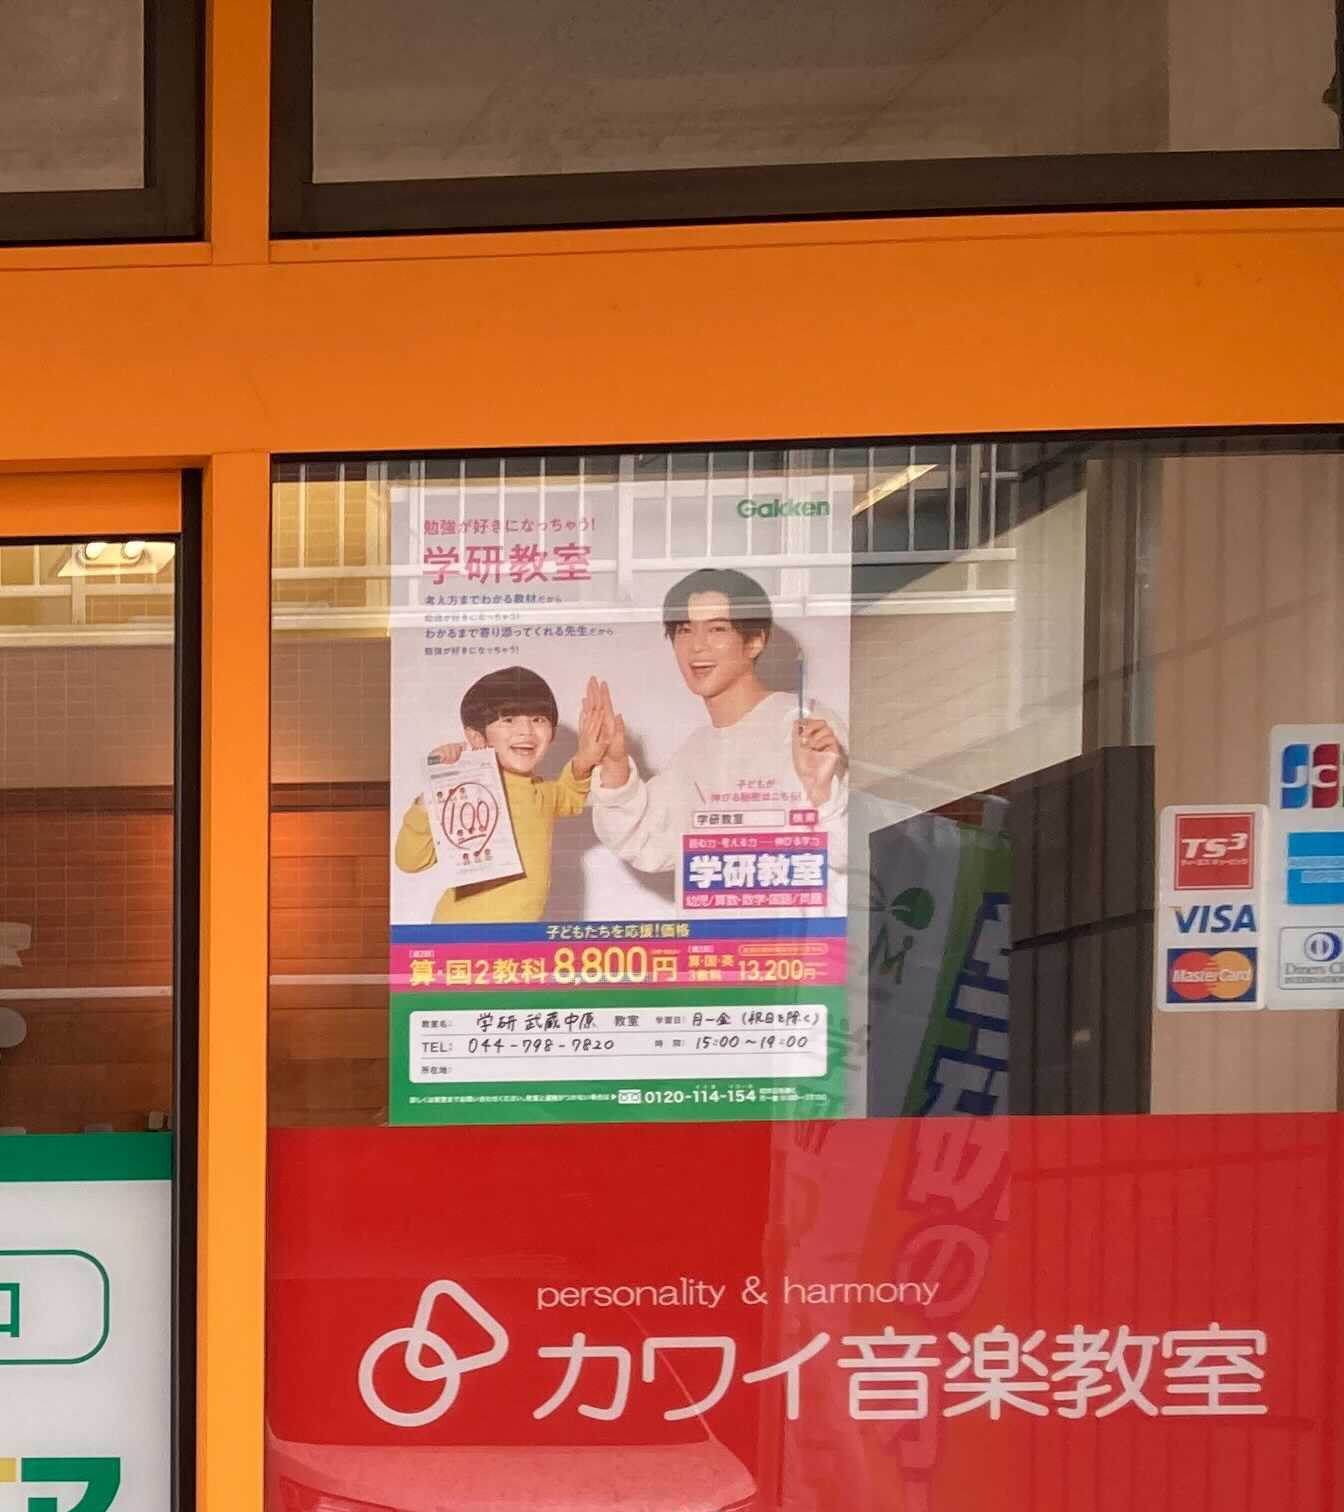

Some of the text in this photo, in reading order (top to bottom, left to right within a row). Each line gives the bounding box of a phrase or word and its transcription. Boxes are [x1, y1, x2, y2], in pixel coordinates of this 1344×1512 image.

[736, 498, 830, 519] Gakken
[423, 542, 592, 585] 学研教室
[689, 853, 824, 888] 学研教室
[1169, 904, 1257, 933] VISA
[546, 923, 689, 940] 子どもたちを応援!価格
[1172, 968, 1251, 983] MasterCard
[477, 1013, 517, 1032] 学研
[614, 1015, 639, 1027] 教室
[644, 1089, 757, 1104] 0120-114-154
[537, 1276, 940, 1312] personality & harmony
[532, 1322, 1268, 1422] カワイ音楽教室
